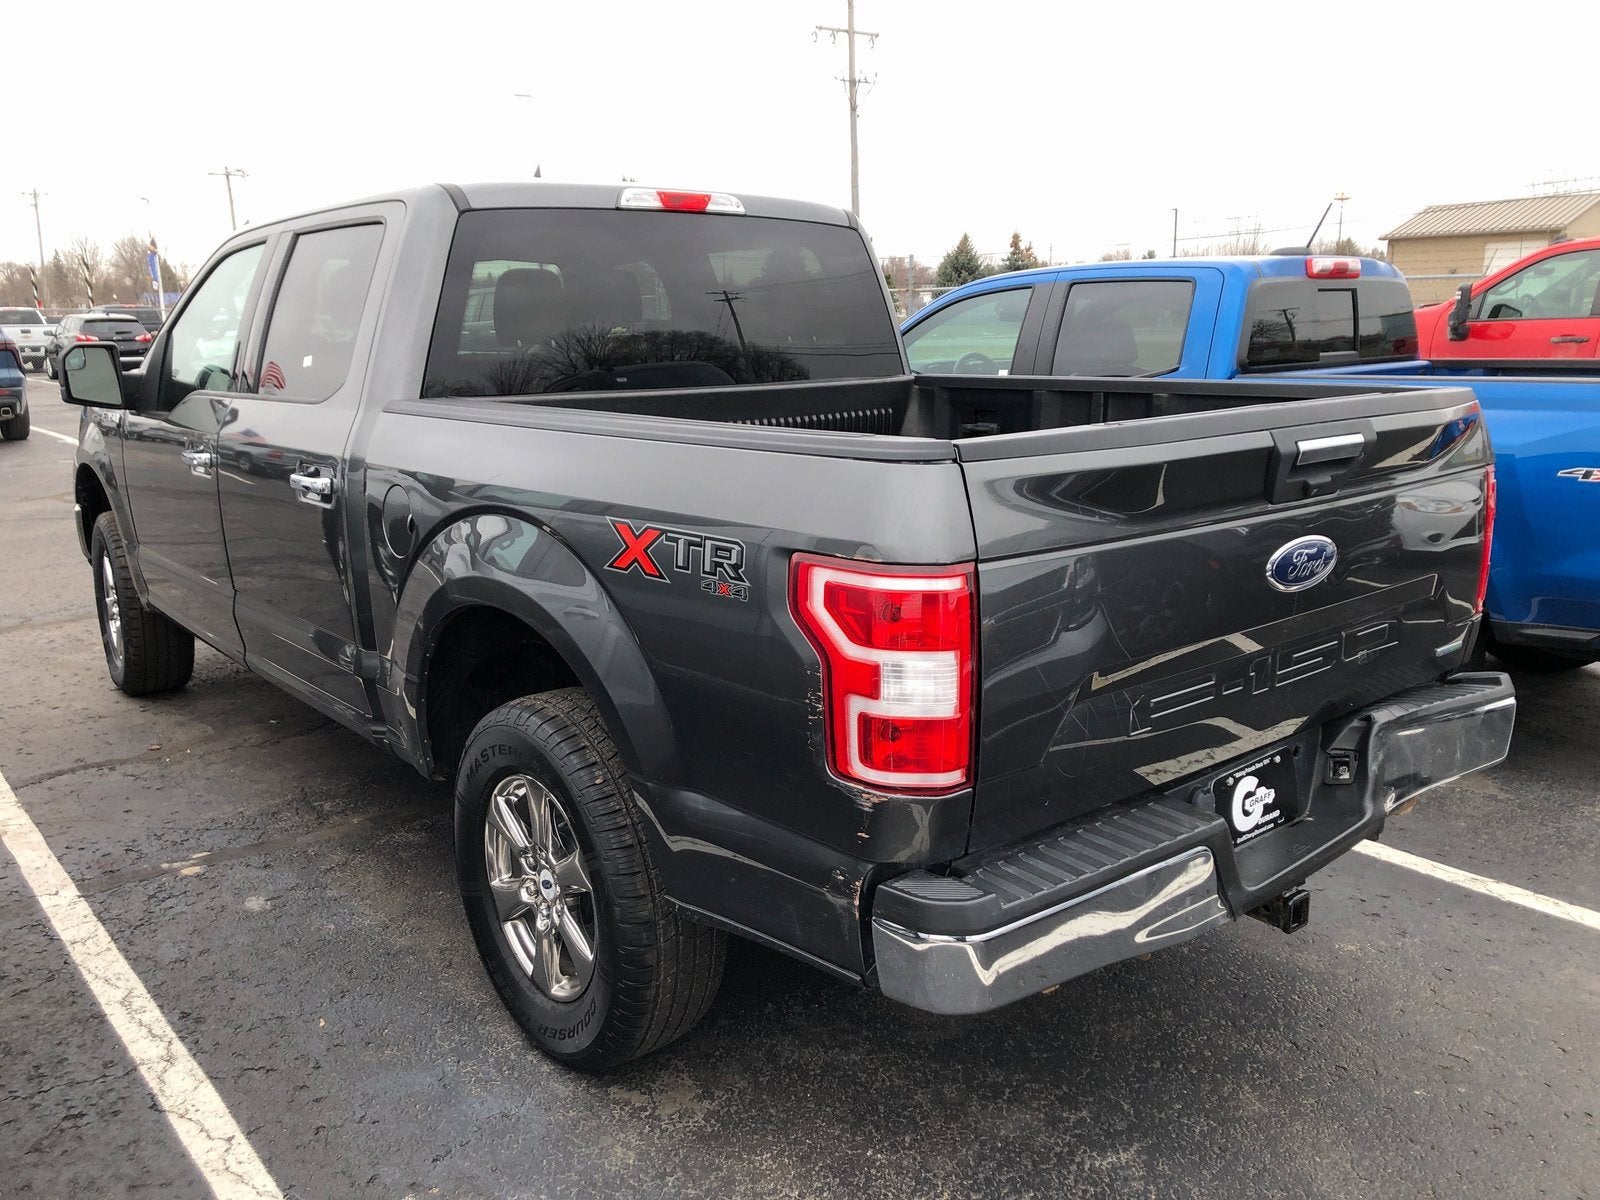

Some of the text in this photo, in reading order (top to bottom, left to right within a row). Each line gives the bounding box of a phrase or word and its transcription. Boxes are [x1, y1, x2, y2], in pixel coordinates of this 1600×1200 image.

[603, 515, 751, 586] XTR
[1287, 547, 1327, 579] Ford
[1129, 618, 1399, 736] F-150
[1249, 790, 1273, 808] GRAFF
